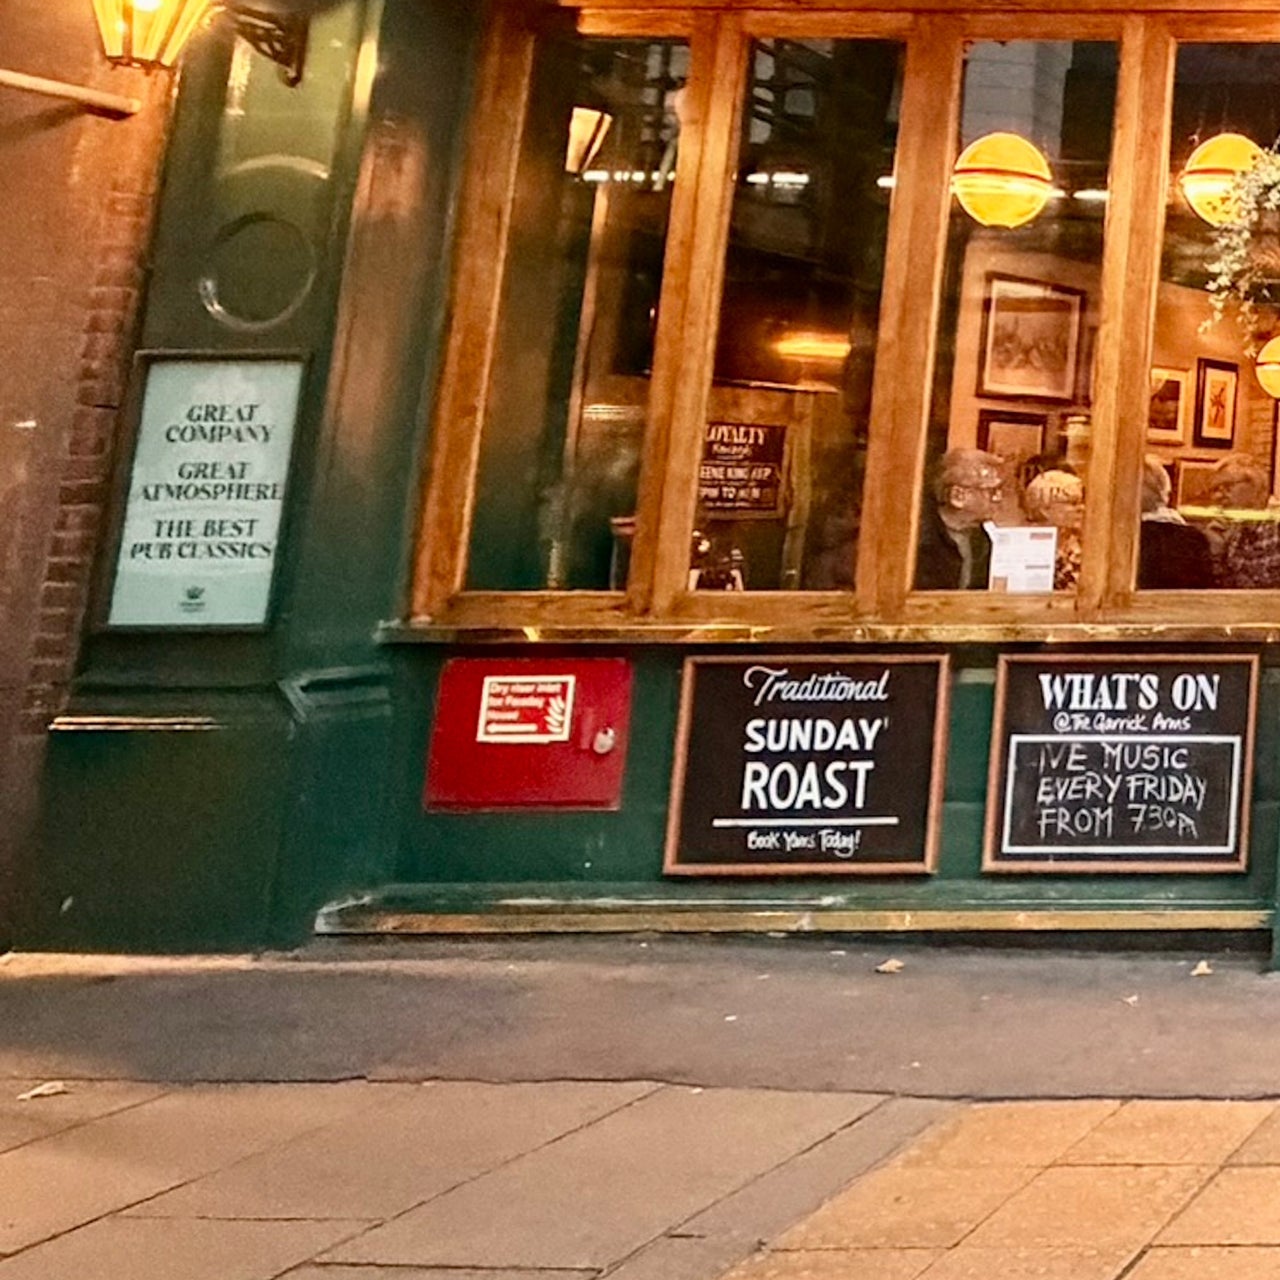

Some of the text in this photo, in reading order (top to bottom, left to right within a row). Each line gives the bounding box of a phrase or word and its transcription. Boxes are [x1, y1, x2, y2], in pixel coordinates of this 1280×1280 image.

[186, 404, 261, 422] GREAT
[165, 425, 275, 443] COMPANY
[177, 462, 252, 480] GREAT
[140, 483, 283, 502] ATMOSPHERE
[153, 519, 260, 538] THE BEST
[130, 541, 273, 560] PUB CLASSICS
[743, 665, 890, 706] Traditional
[1038, 673, 1220, 711] WHAT'S ON
[743, 718, 883, 753] SUNDAY
[1092, 712, 1149, 732] Garrick
[1152, 712, 1192, 731] Arms
[1038, 742, 1189, 775] IVE MUSIC
[741, 760, 875, 810] ROAST
[1036, 771, 1207, 811] EVERY FRIDAY
[1037, 806, 1113, 840] FROM
[747, 830, 782, 850] Book
[818, 829, 862, 858] Today!
